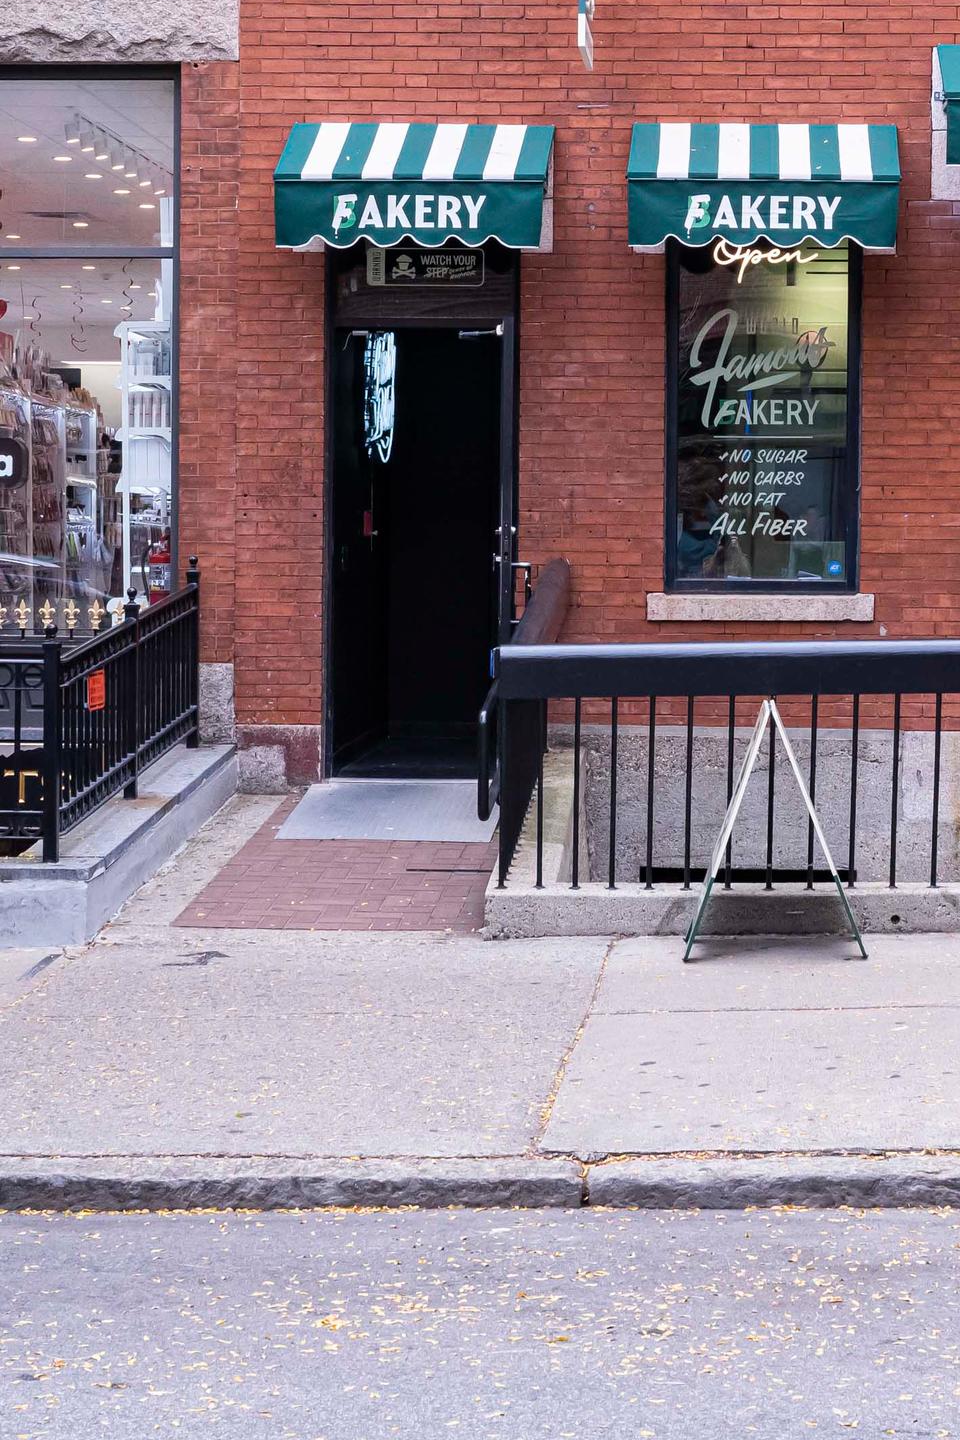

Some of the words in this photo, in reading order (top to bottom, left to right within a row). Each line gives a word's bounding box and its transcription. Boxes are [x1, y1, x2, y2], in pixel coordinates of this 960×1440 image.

[421, 255, 451, 265] WATCH
[453, 255, 476, 265] YOUR
[713, 239, 819, 284] Open
[729, 449, 751, 464] NO
[754, 449, 808, 464] SUGAR
[728, 471, 750, 485] NO
[754, 471, 805, 486] CARBS
[729, 492, 751, 506] NO
[754, 492, 786, 506] FAT
[709, 512, 747, 536] ALL
[751, 512, 808, 537] FIBER
